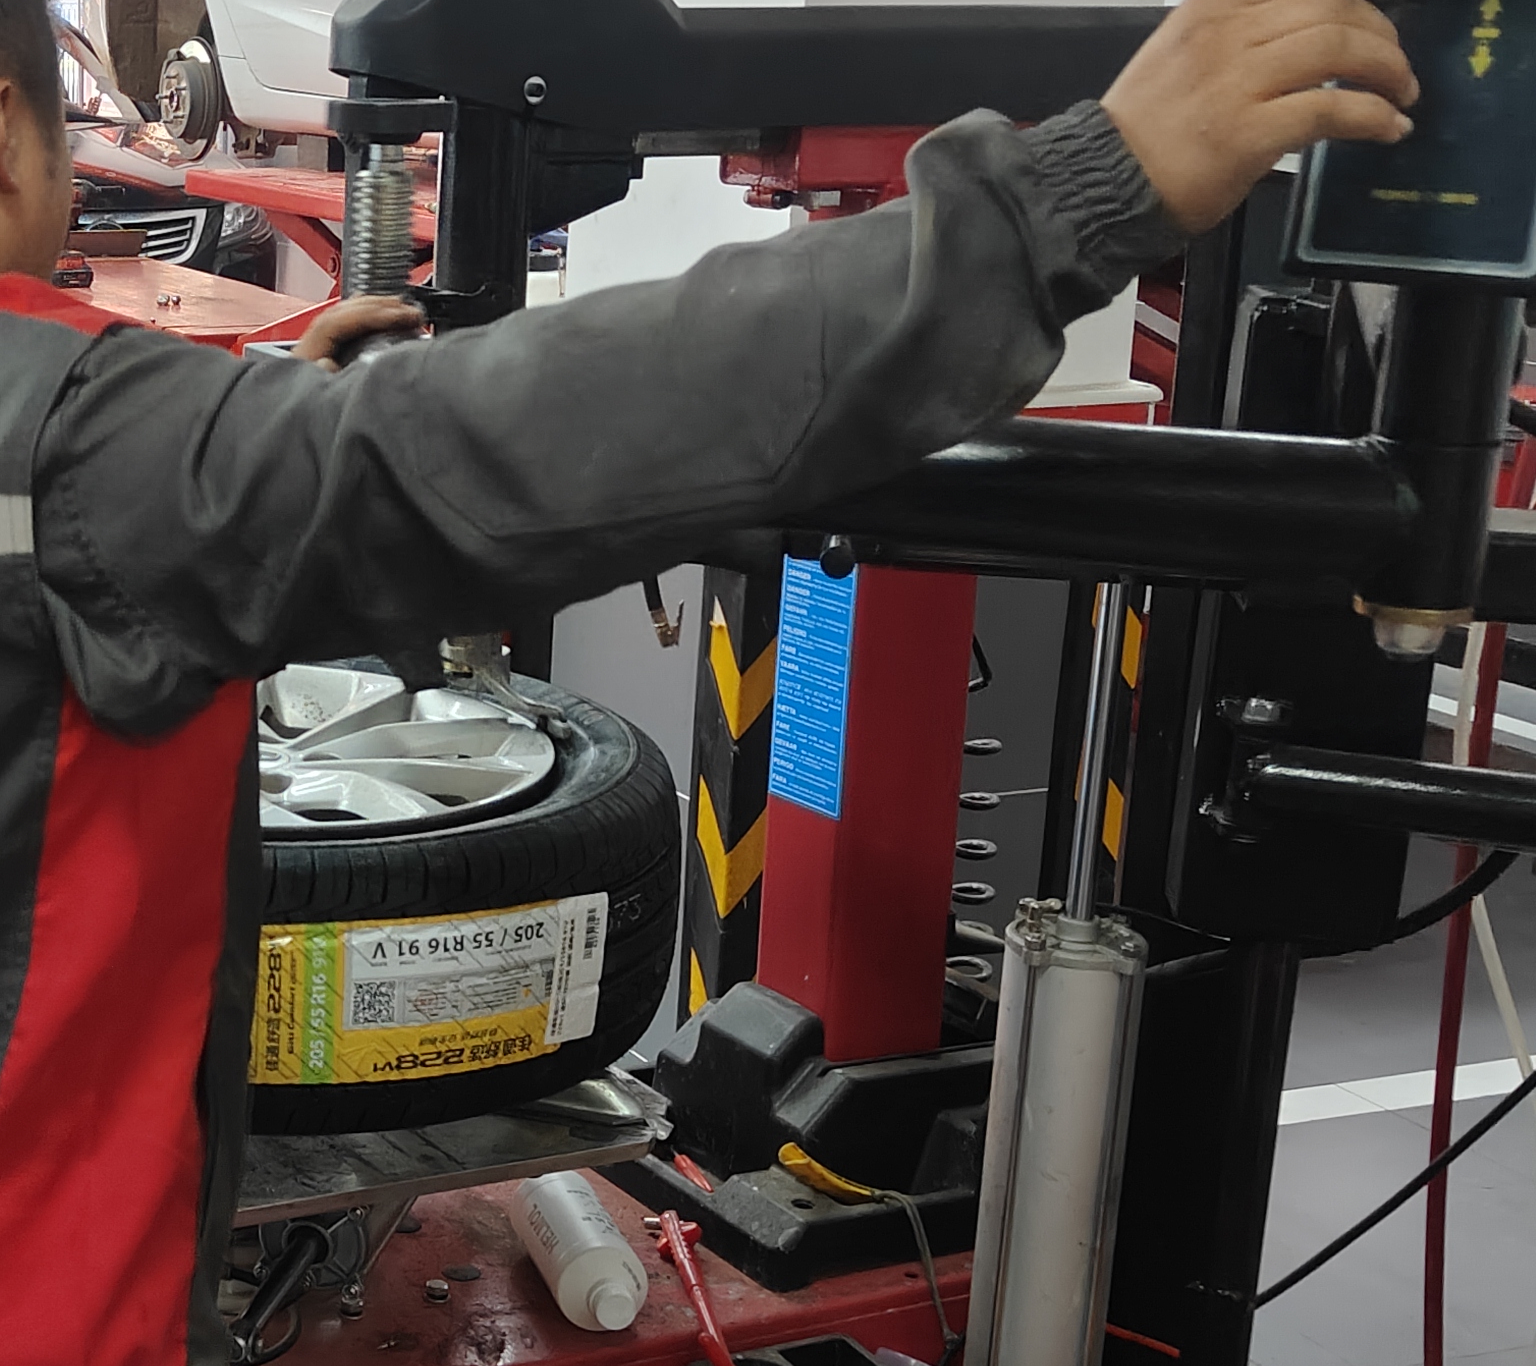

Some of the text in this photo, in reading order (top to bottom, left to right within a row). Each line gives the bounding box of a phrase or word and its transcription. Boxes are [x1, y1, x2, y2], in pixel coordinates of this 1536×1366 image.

[472, 930, 495, 949] 55
[514, 921, 544, 943] 205
[372, 942, 387, 959] V
[396, 939, 420, 956] 91
[427, 936, 465, 953] R16
